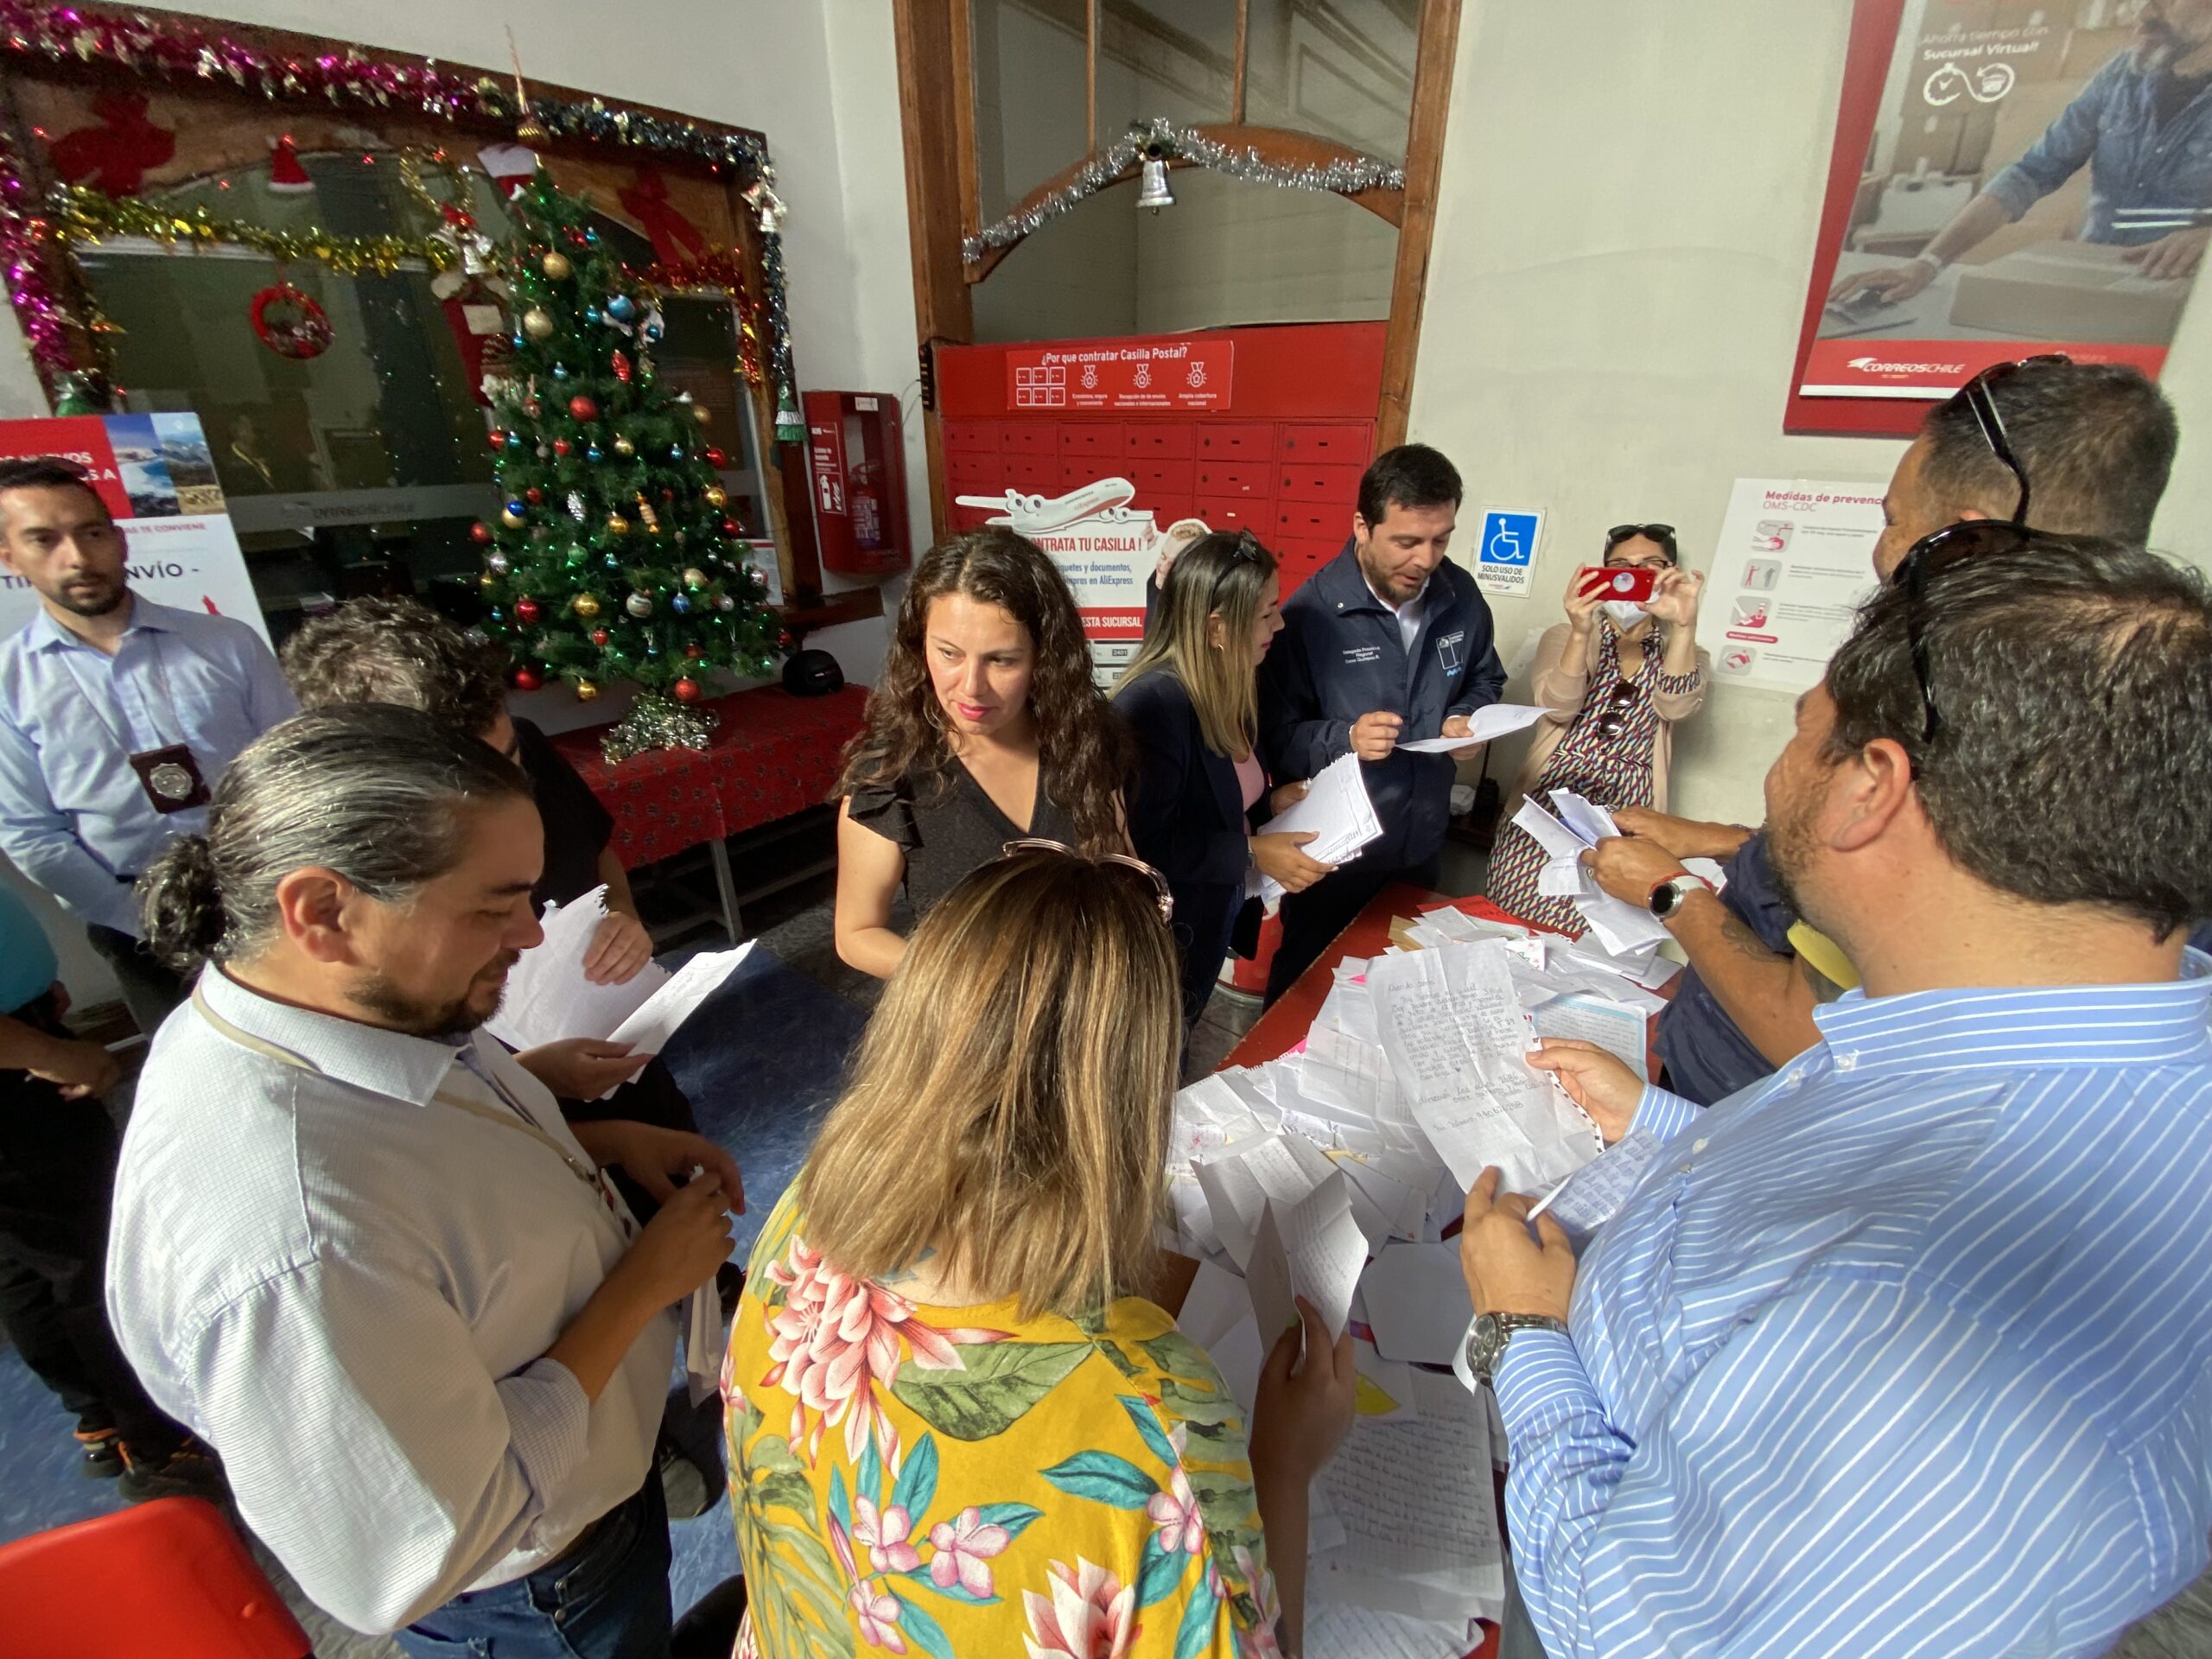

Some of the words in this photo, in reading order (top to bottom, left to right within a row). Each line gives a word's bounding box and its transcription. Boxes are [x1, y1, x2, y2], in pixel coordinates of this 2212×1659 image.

[1923, 44, 1984, 60] Sucursal
[1041, 352, 1060, 365] ¿Por
[1077, 350, 1119, 362] contratar
[1121, 347, 1150, 360] Casilla
[1152, 346, 1188, 359] Postal?
[1765, 491, 1812, 501] Medidas
[1815, 493, 1830, 502] de
[1832, 495, 1883, 505] prevenc
[1030, 537, 1076, 551] ONTRATA
[1078, 537, 1091, 551] TU
[1094, 537, 1136, 551] CASILLA
[124, 561, 183, 580] NVÍO
[1090, 562, 1133, 573] documentos,
[1481, 564, 1499, 574] SOLO
[1499, 565, 1513, 575] USO
[1513, 567, 1523, 575] DE
[1099, 576, 1134, 588] AliExpress
[1477, 572, 1525, 584] MINUSVALIDOS
[1102, 616, 1142, 627] SUCURSAL
